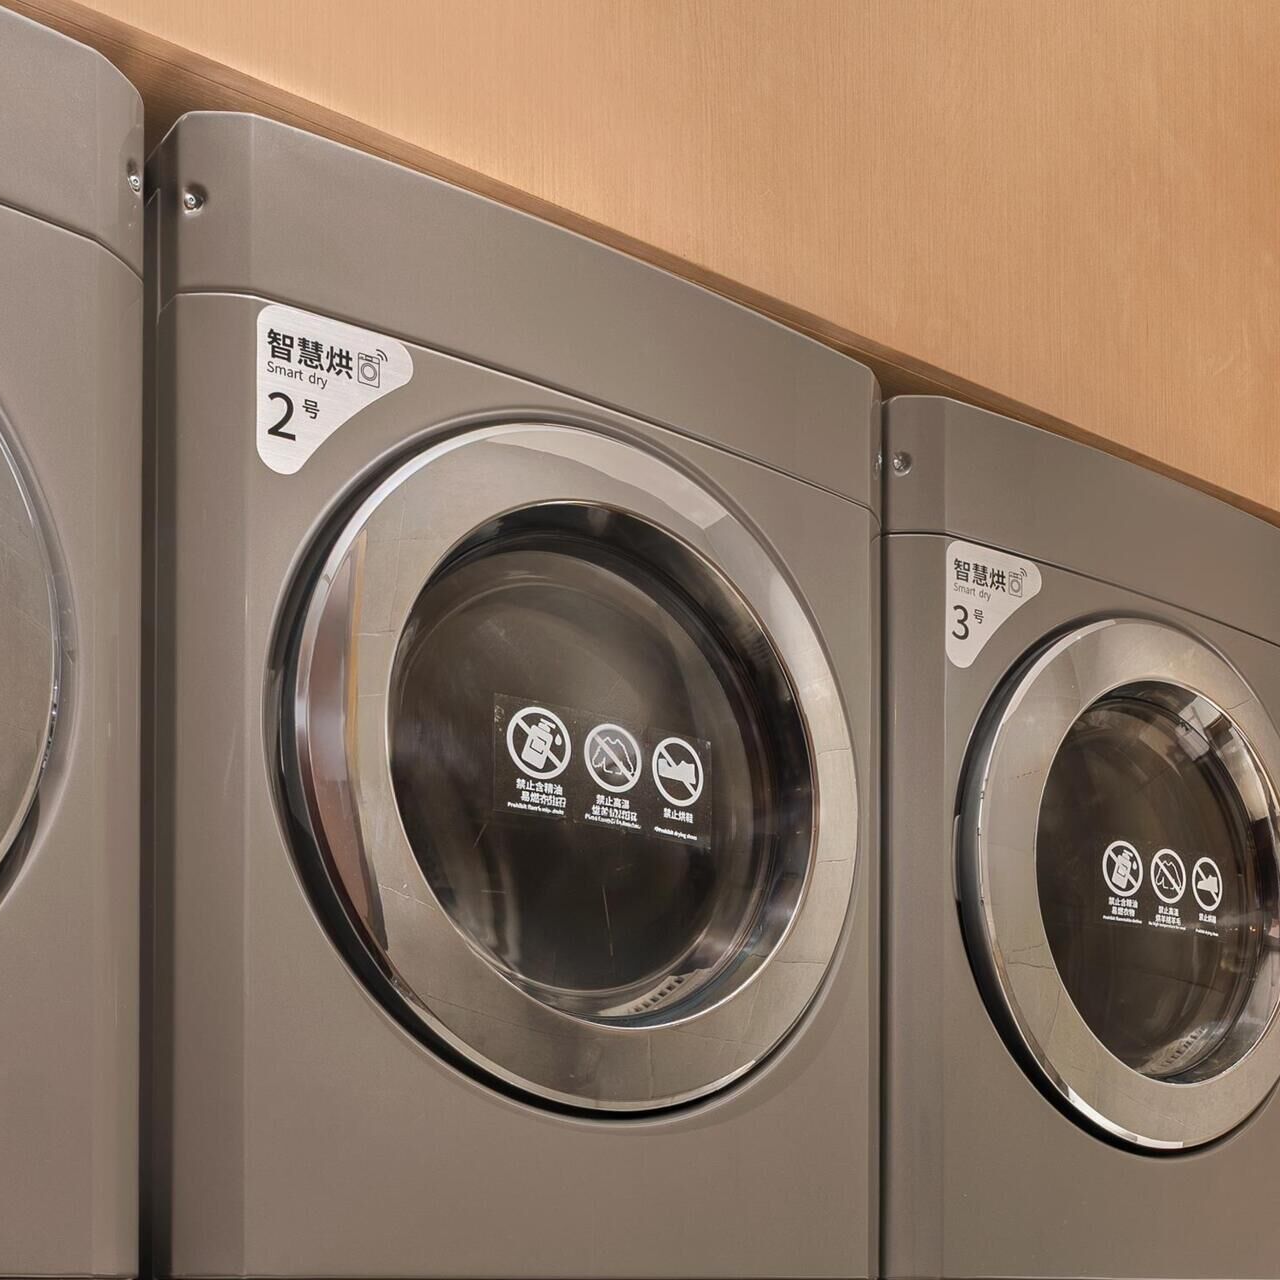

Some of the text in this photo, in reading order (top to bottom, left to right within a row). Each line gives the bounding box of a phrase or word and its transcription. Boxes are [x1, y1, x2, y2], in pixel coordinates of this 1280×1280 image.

[267, 328, 353, 380] 智慧烘
[267, 361, 327, 389] Smart dry
[267, 391, 320, 441] 2 号
[954, 558, 1006, 592] 智慧烘
[954, 582, 991, 601] Smart dry
[952, 605, 984, 640] 3 号
[516, 778, 563, 795] 禁止含精油
